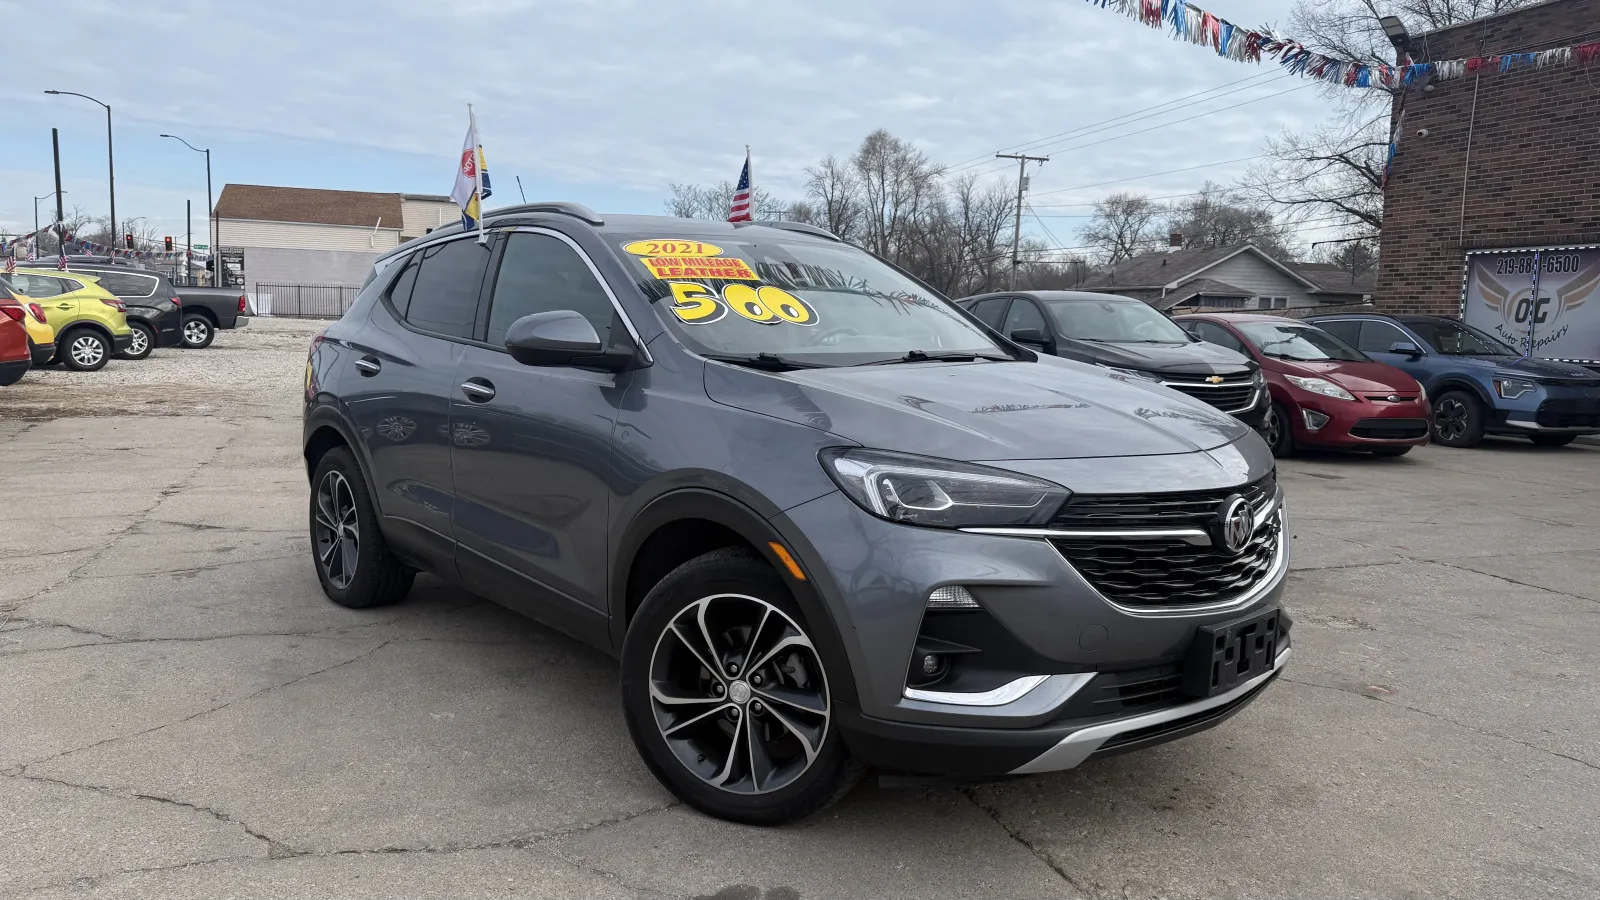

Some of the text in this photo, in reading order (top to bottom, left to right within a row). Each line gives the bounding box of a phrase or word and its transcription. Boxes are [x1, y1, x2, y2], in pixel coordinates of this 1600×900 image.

[646, 243, 704, 254] 2021
[648, 258, 743, 268] LOW MILEAGE
[1497, 255, 1580, 274] 219-88-6500
[658, 268, 754, 278] LEATHER
[668, 281, 820, 327] 500
[1514, 298, 1551, 324] OG
[1495, 324, 1569, 351] Auto Repairs
